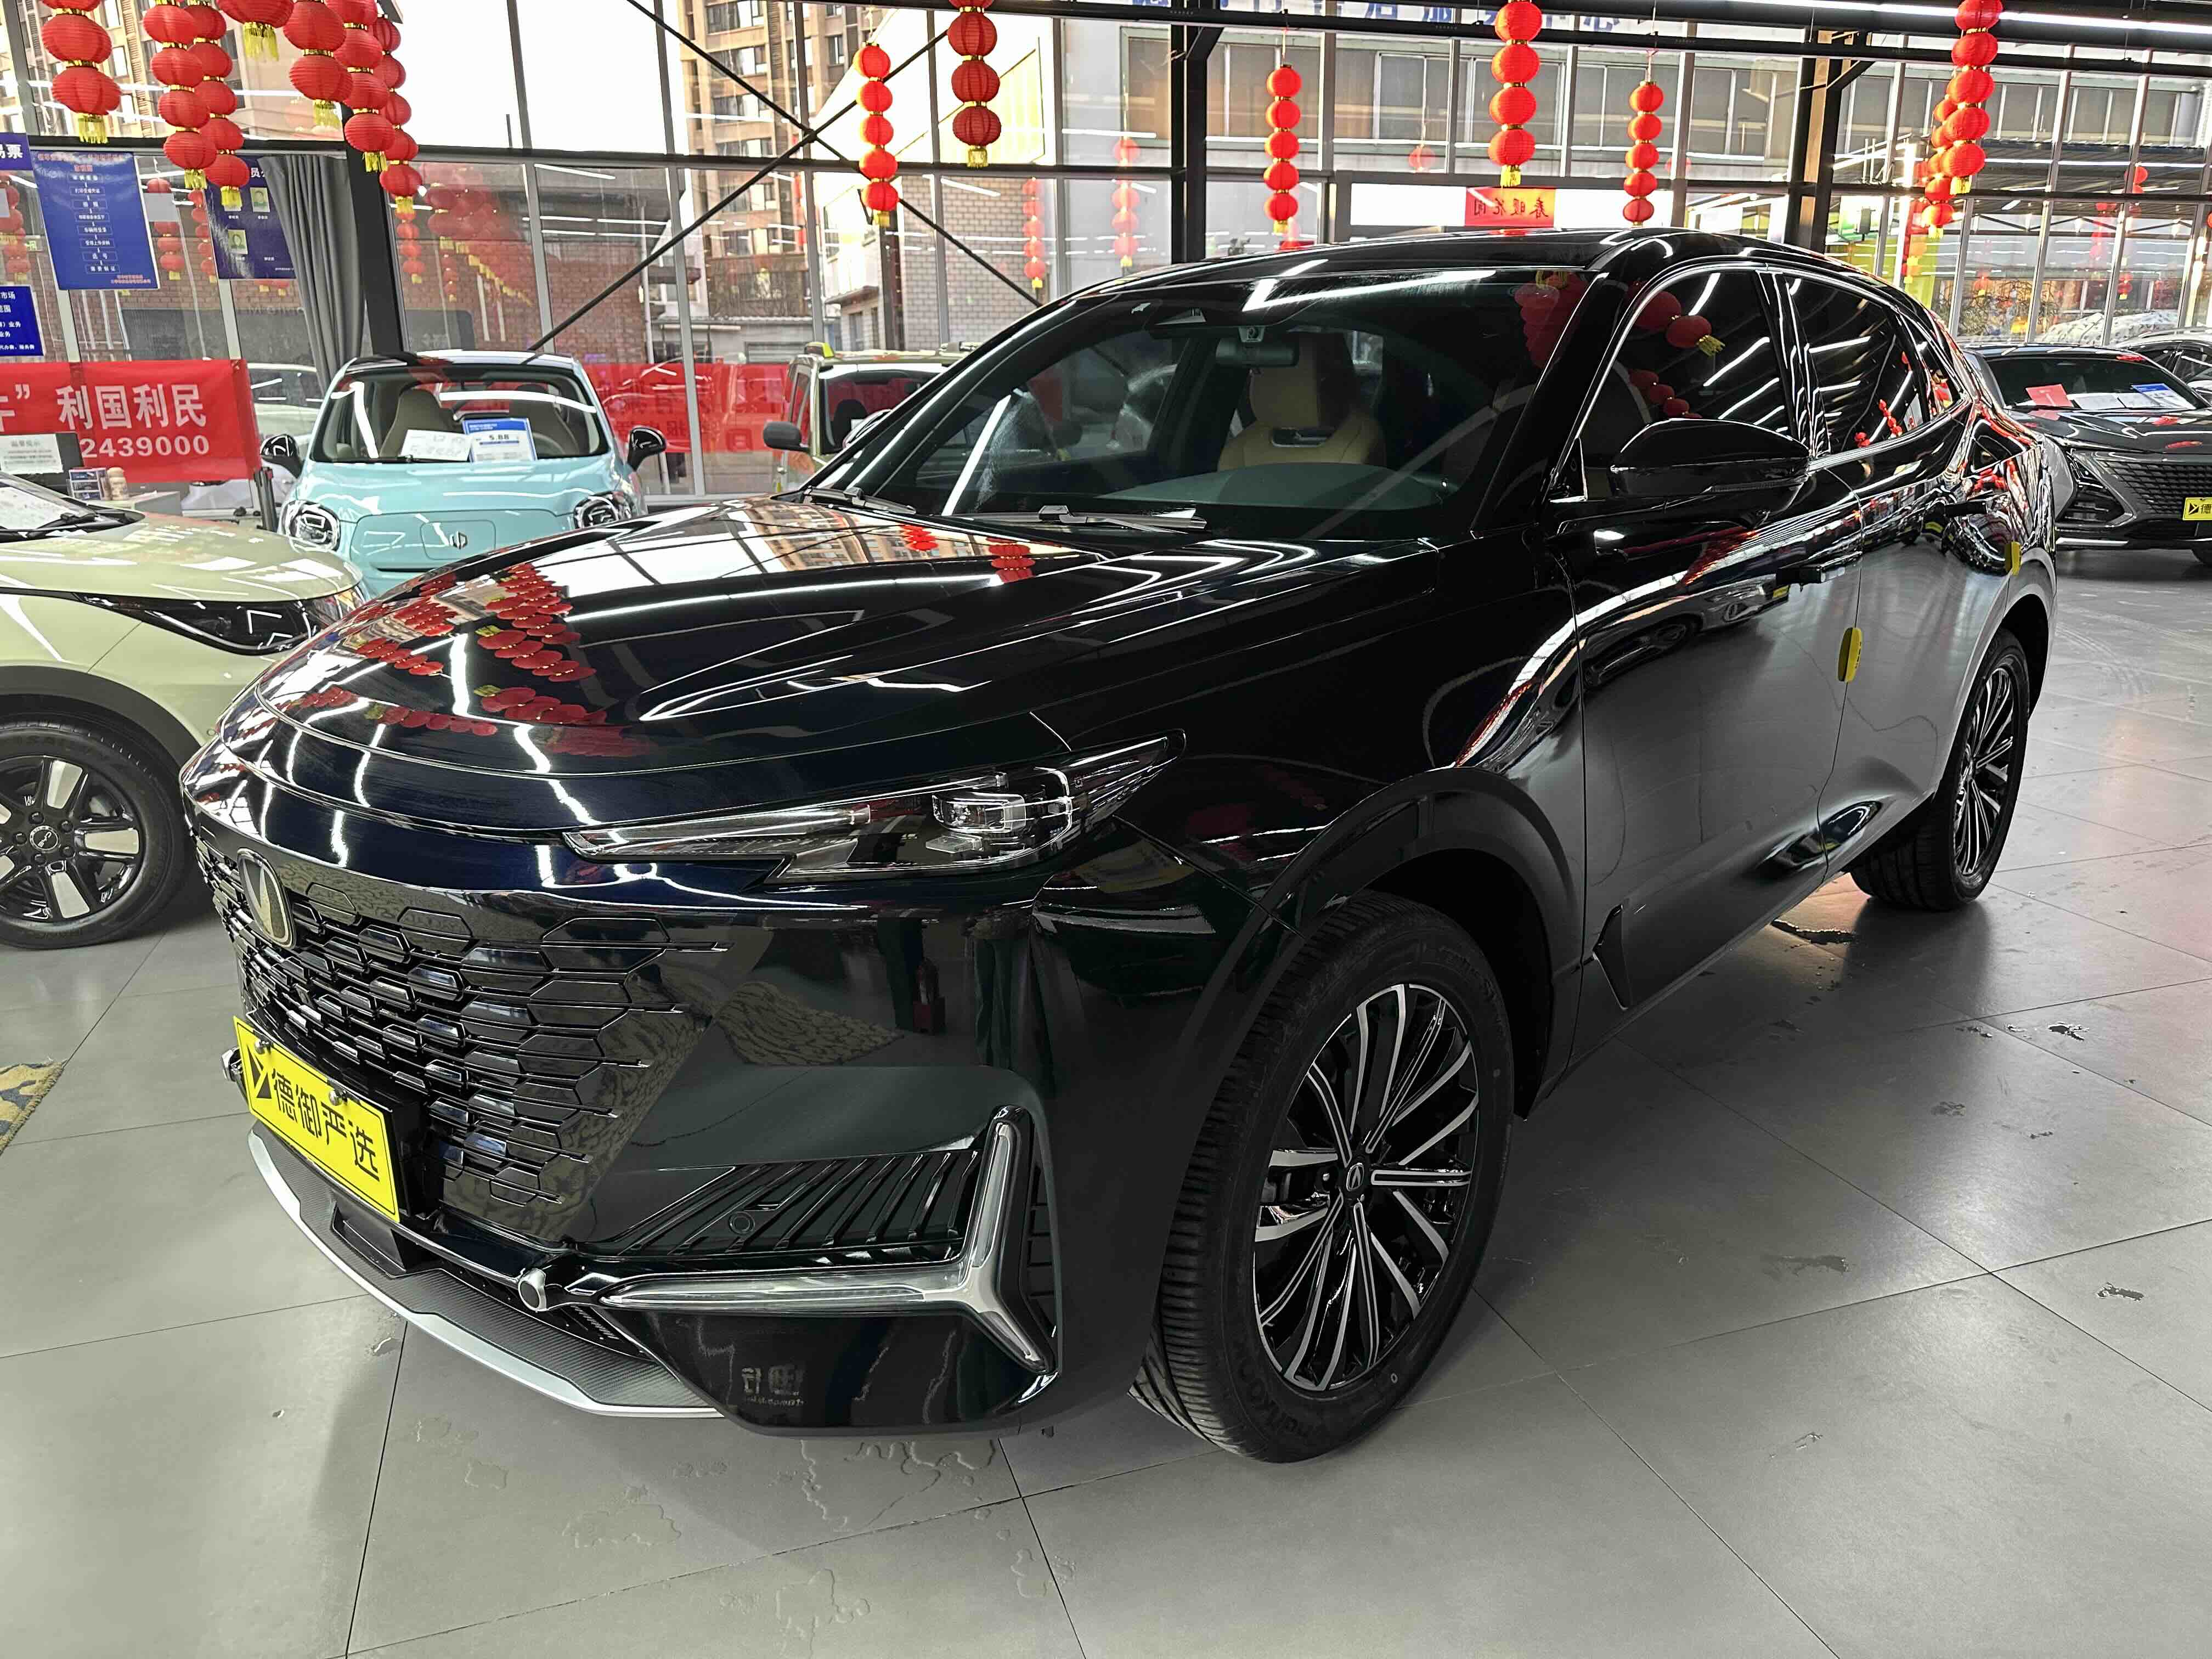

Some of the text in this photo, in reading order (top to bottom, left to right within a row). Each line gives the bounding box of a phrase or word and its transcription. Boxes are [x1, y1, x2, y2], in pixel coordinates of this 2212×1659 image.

[55, 383, 206, 431] 利国利民
[80, 435, 210, 459] 2439000
[271, 1067, 381, 1183] 德御严选
